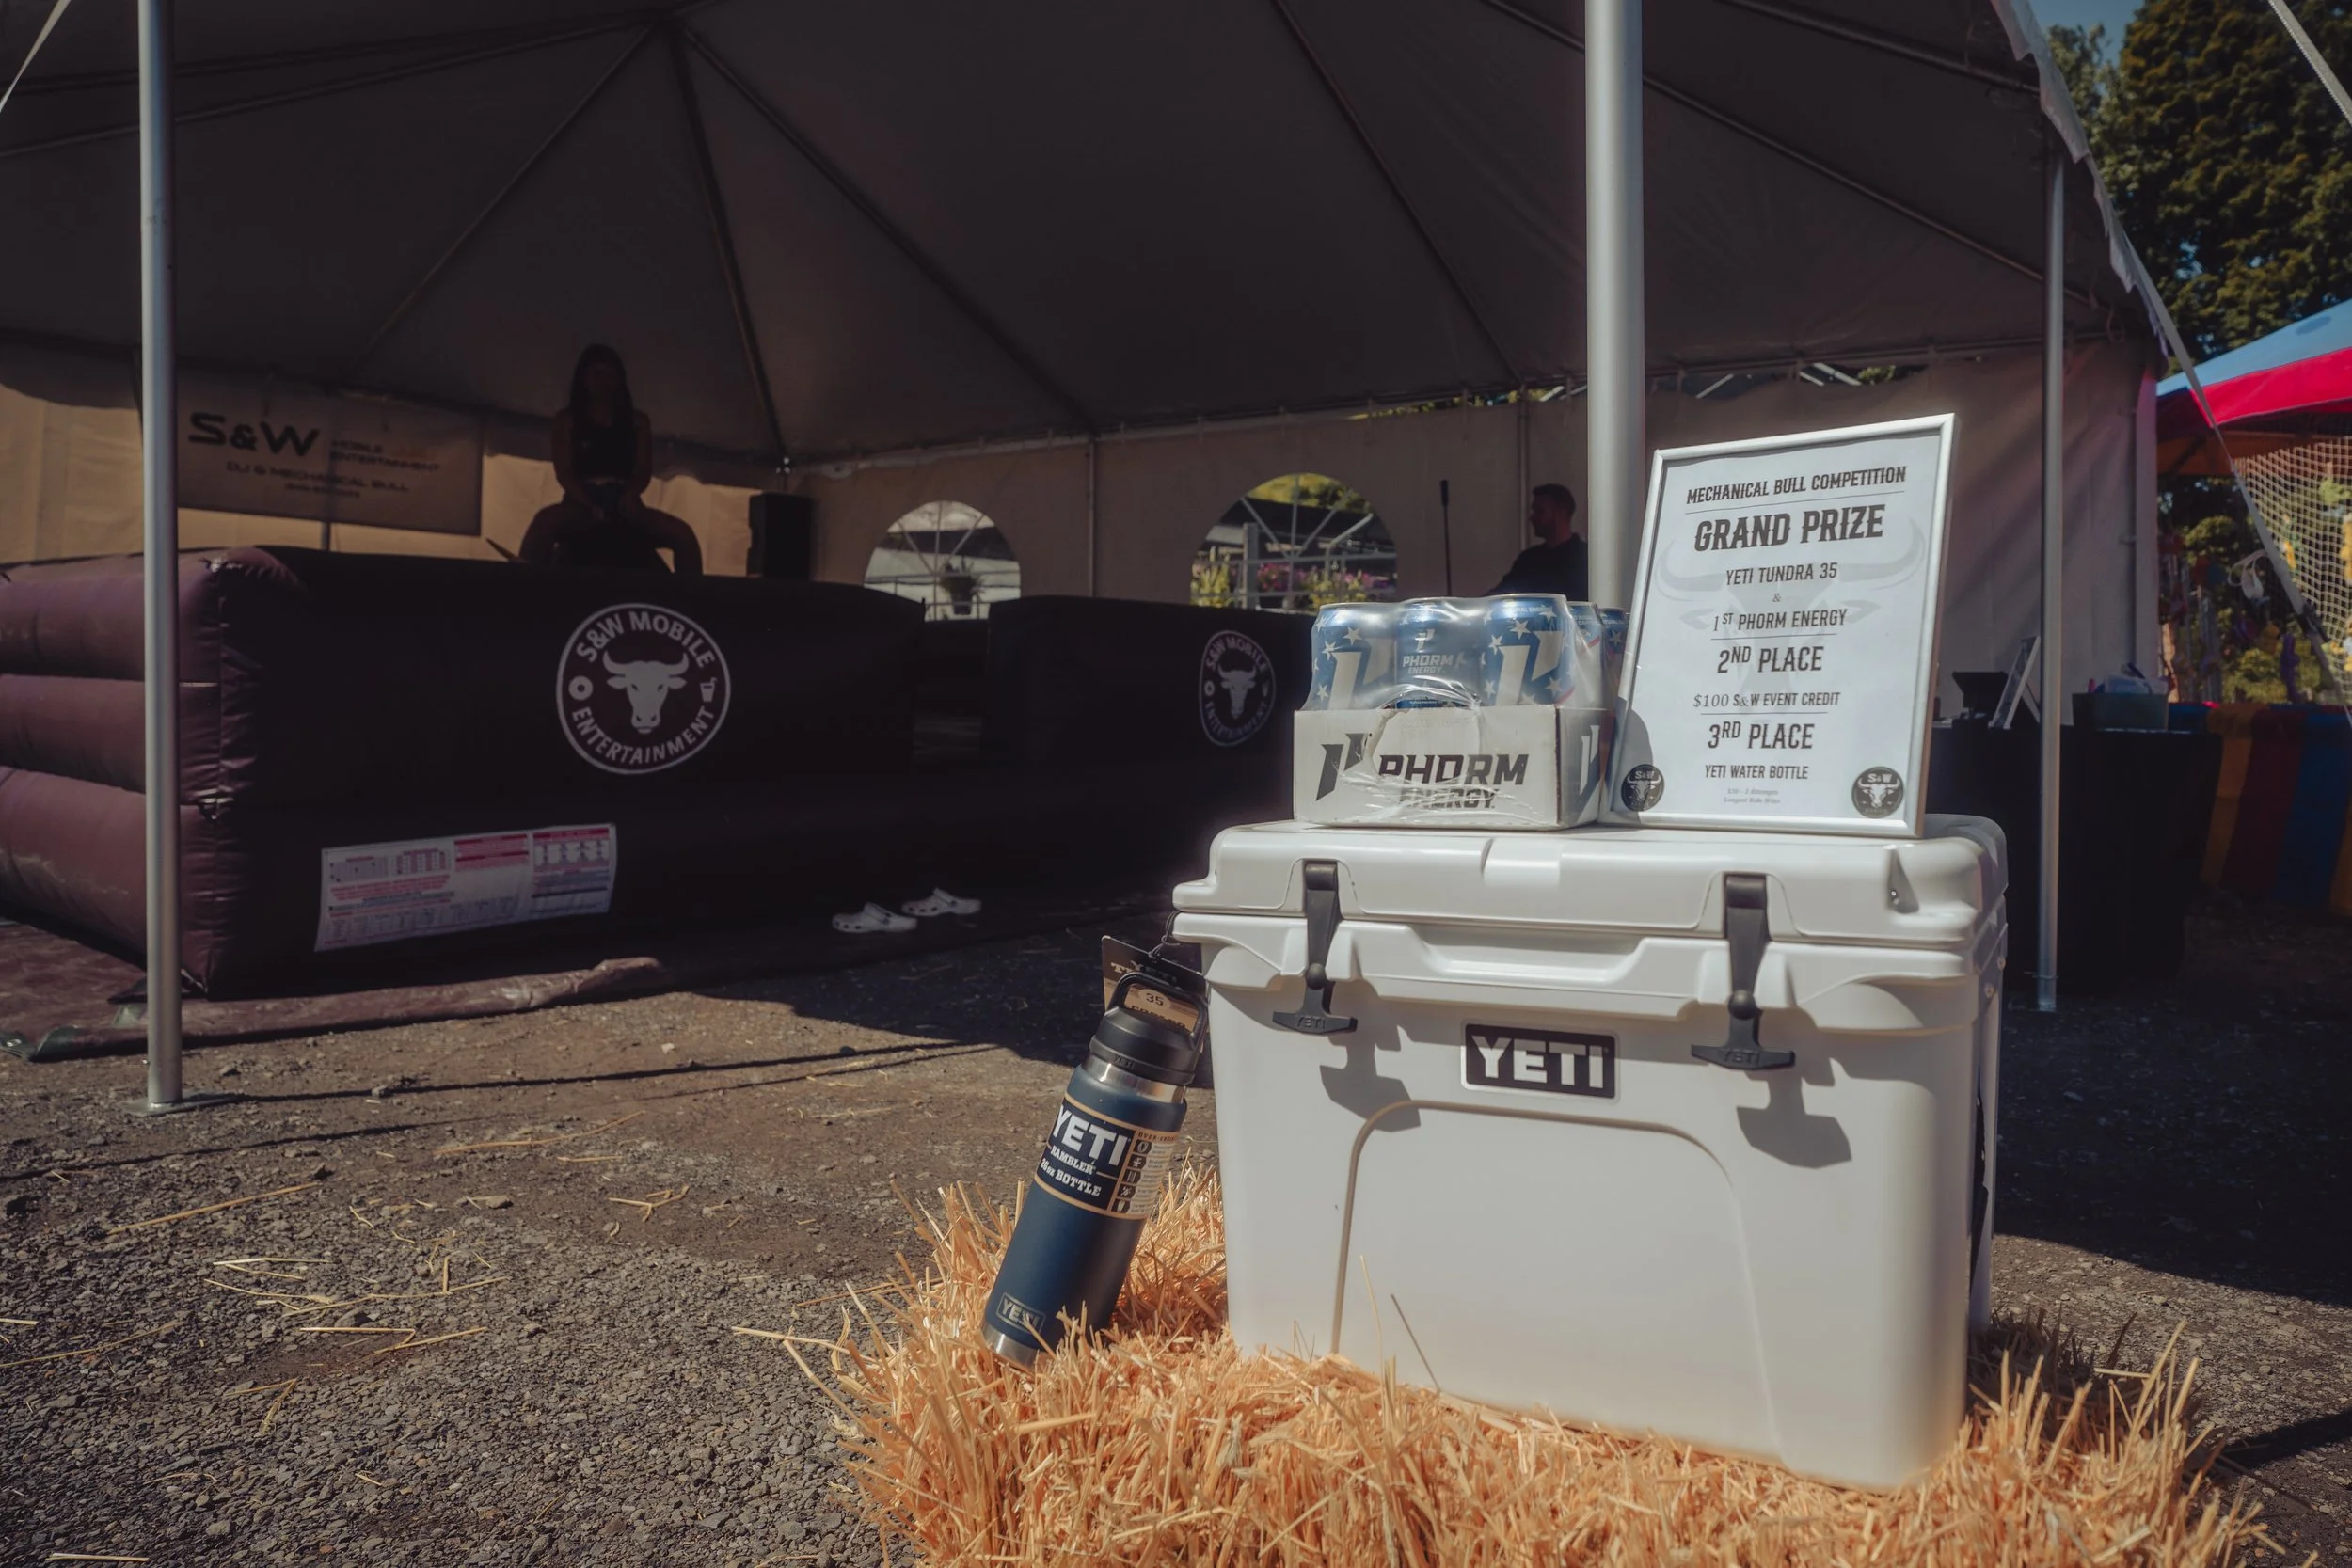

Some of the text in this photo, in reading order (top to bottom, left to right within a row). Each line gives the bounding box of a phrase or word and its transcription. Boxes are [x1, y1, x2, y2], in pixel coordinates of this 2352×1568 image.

[188, 411, 320, 458] S&W
[1686, 465, 1908, 505] MECHANICAL BULL COMPETITION
[1693, 504, 1886, 552] GRAND PRIZE
[1725, 562, 1838, 586] YETI TUNDRA 35
[1772, 593, 1782, 603] &
[1738, 611, 1788, 630] PHORM
[1791, 608, 1848, 627] ENERGY
[576, 610, 716, 668] S&W MOBILE
[1402, 654, 1454, 668] PHORM
[1407, 666, 1442, 674] ENERGY
[1717, 646, 1825, 674] 2ND PLACE
[1693, 693, 1729, 708] $100
[1762, 692, 1799, 706] EVENT
[1801, 691, 1841, 706] CREDIT
[572, 706, 715, 765] ENTERTAINMENT
[1708, 721, 1816, 750] 3RD PLACE
[1378, 753, 1529, 785] PHORM
[1705, 765, 1810, 780] YETI WATER BOTTLE
[1146, 992, 1164, 1006] 35
[1297, 1016, 1326, 1030] YETI
[1470, 1035, 1604, 1089] YETI
[1053, 1104, 1129, 1167] YETI
[1050, 1145, 1094, 1176] RAMBLER
[1055, 1168, 1102, 1197] BOTTLE
